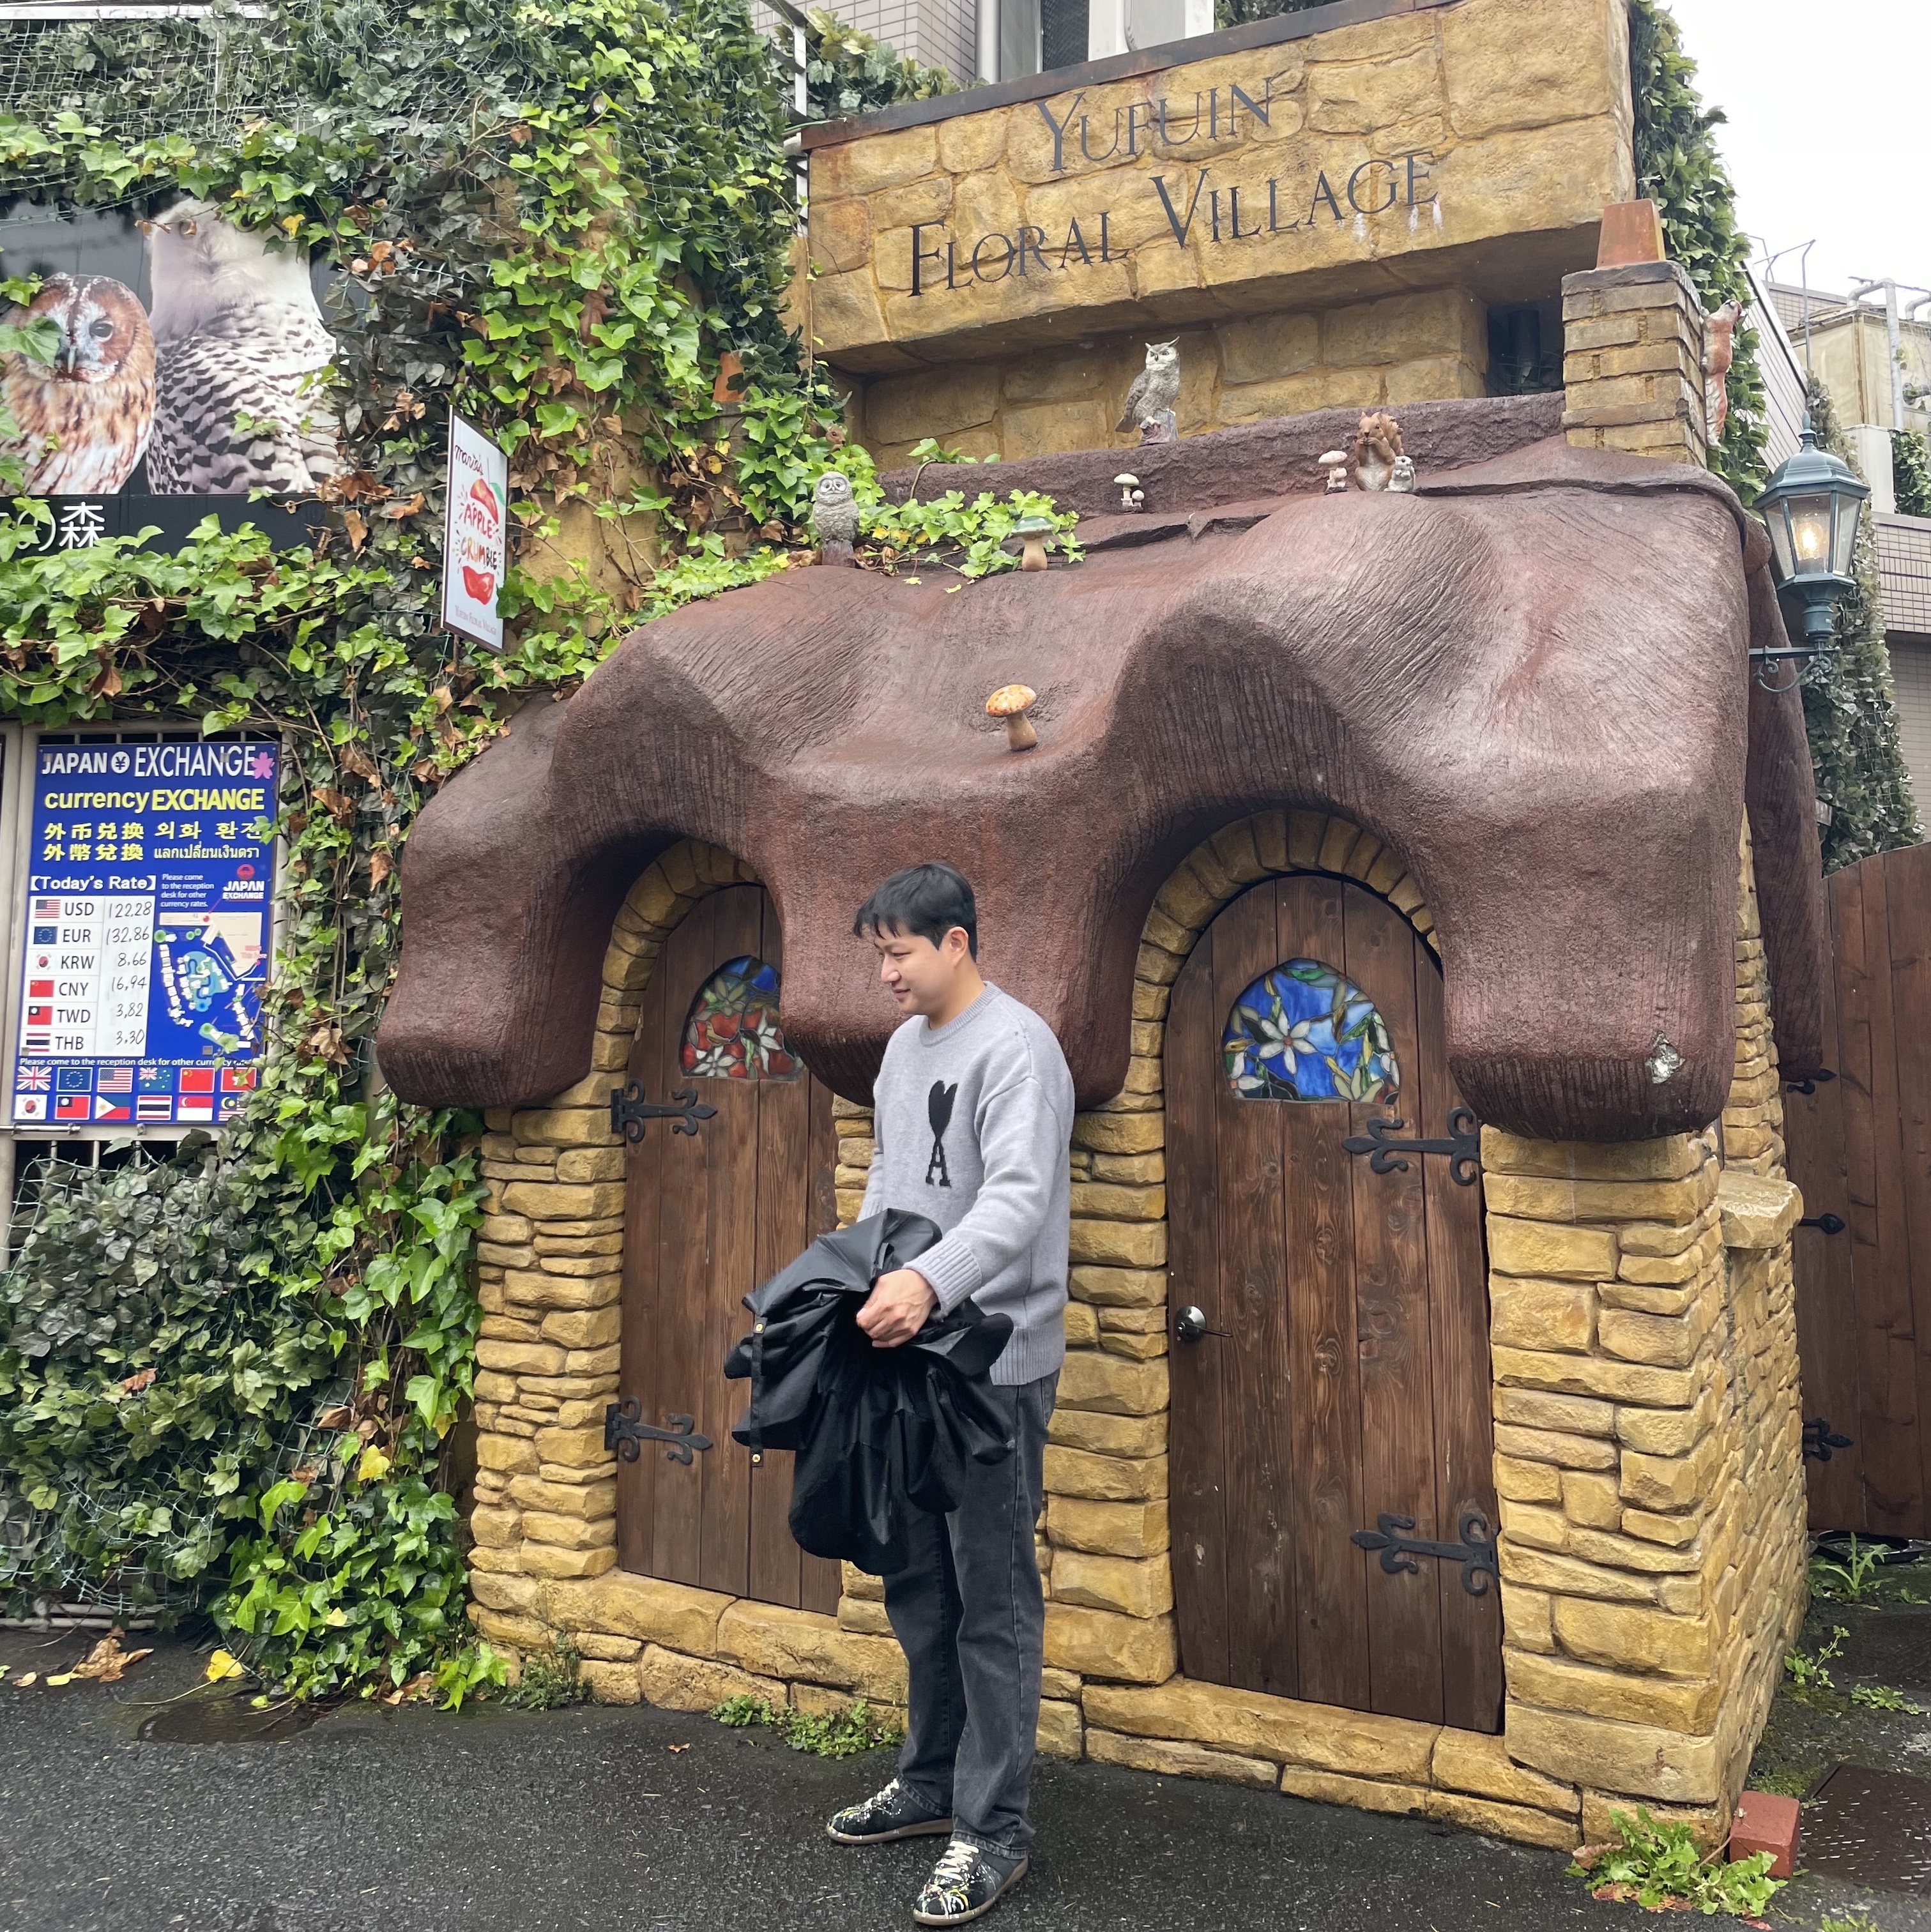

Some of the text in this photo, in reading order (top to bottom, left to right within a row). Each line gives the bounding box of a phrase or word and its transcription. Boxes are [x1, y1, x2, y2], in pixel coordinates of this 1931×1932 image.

[1034, 77, 1278, 172] YUFUIN
[908, 151, 1439, 297] FLORAL VILLAGE
[464, 503, 492, 539] APPLE
[461, 536, 497, 570] CRUMBLE
[42, 752, 107, 774] JAPAN
[134, 745, 256, 777] EXCHANGE
[45, 788, 265, 814] currency EXCHANGE
[155, 821, 202, 840] 외화
[223, 881, 265, 892] JAPAN
[65, 902, 95, 916] USD
[63, 929, 91, 942] EUR
[61, 955, 95, 969] KRW
[59, 982, 89, 996] CNY
[57, 1009, 91, 1023] TWD
[55, 1036, 84, 1050] THB
[96, 1058, 136, 1067] reception
